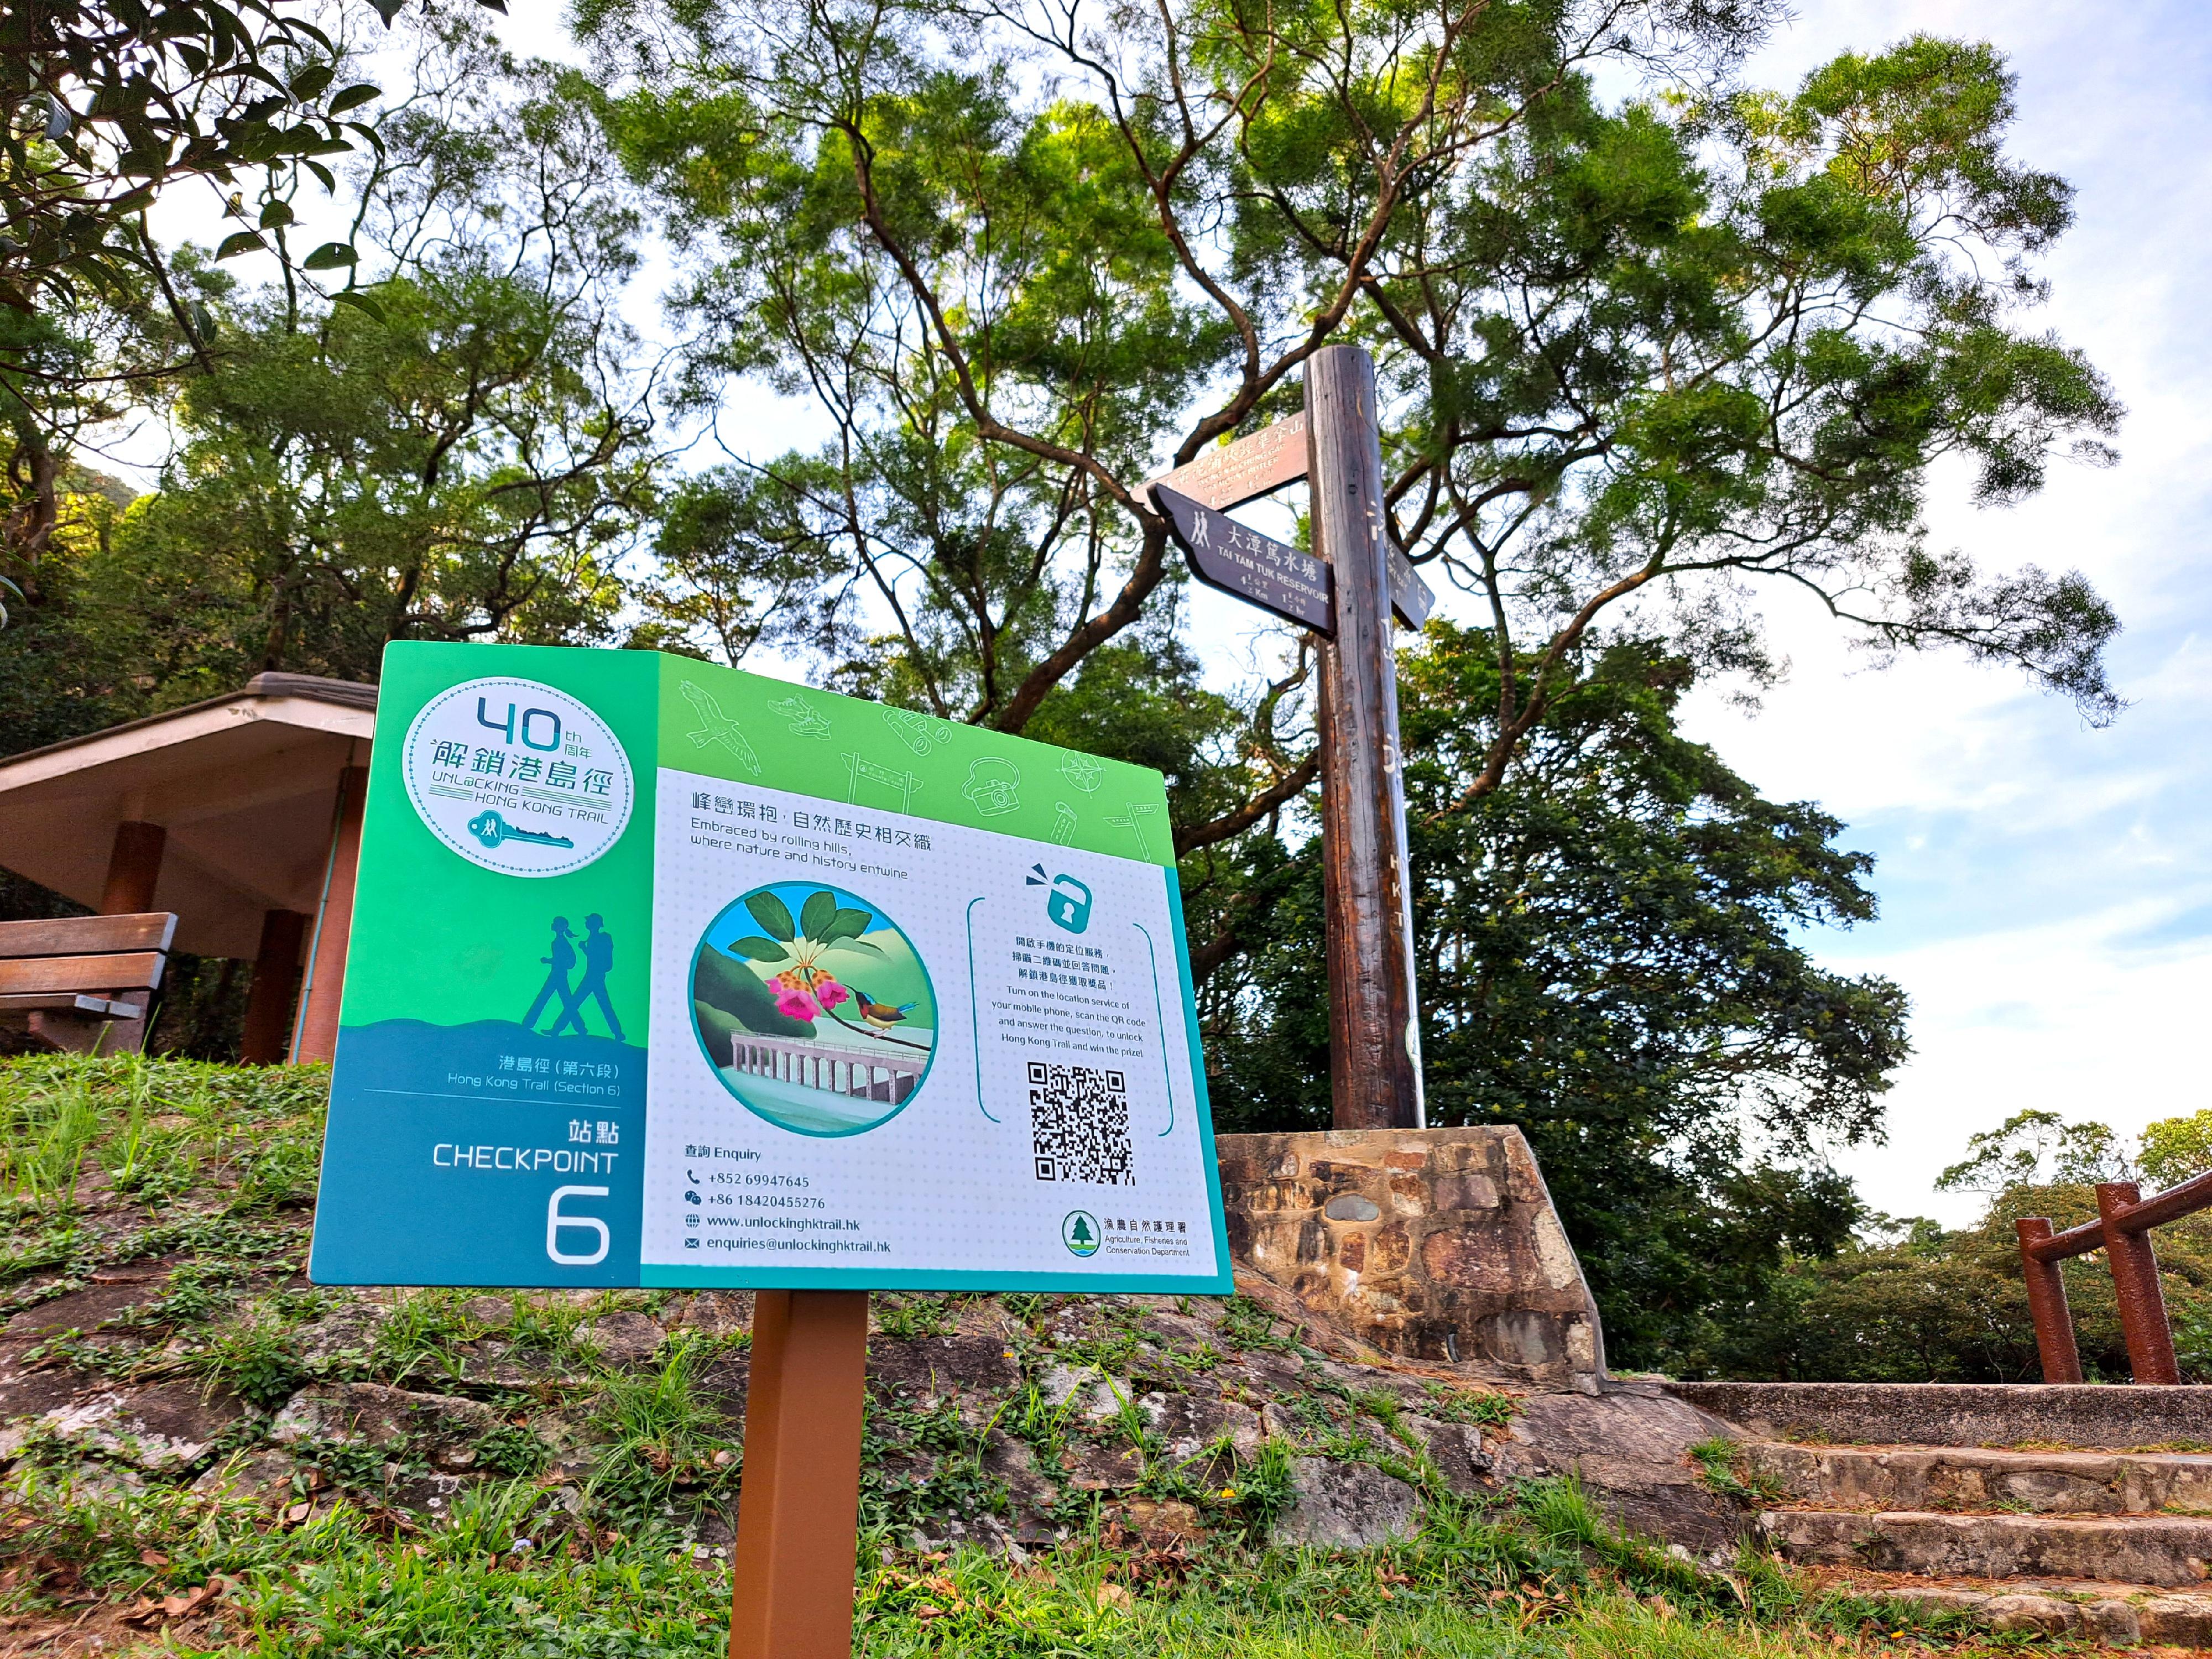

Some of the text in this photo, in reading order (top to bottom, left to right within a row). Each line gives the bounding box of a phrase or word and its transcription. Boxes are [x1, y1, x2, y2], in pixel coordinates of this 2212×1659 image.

[1247, 456, 1279, 475] BUTLER
[1228, 525, 1317, 581] 大潭篤水塘
[1217, 545, 1328, 604] TAI TAM TUK RESERVOIR
[477, 697, 561, 752] 40
[565, 744, 593, 759] 周年
[431, 739, 614, 796] 解鎖港島徑
[475, 792, 608, 824] HONG KONG TRAIL
[691, 817, 852, 856] Embraced by rolling hills,
[691, 834, 907, 880] where nature and history entwine
[1006, 985, 1026, 996] Turn
[1041, 990, 1055, 1000] the
[1056, 992, 1089, 1005] location
[1092, 998, 1119, 1009] service
[1121, 1001, 1130, 1010] of
[992, 1000, 1146, 1027] your mobile phone, scan the QR code
[998, 1018, 1143, 1042] and answer the question, to unlock
[1001, 1034, 1025, 1045] Hong
[1027, 1036, 1050, 1048] Kong
[1052, 1039, 1070, 1049] Trail
[1072, 1041, 1088, 1051] and
[1089, 1044, 1104, 1053] win
[1106, 1045, 1119, 1055] the
[448, 1073, 620, 1097] Hong Kong Trail (Section 6)
[568, 1119, 619, 1144] 站點
[434, 1144, 618, 1173] CHECKPOINT
[685, 1144, 761, 1163] 查詢 Enquiry
[708, 1173, 810, 1188] +852 69947645
[708, 1193, 825, 1209] +86 18420455276
[546, 1185, 610, 1265] 6
[707, 1216, 860, 1233] www.unlockinghktrail.hk
[1104, 1217, 1187, 1234] 漁農自然護理署
[707, 1237, 891, 1254] enquiries@unlockinghktrail.hk
[1106, 1246, 1190, 1257] Conservation Department
[1145, 1236, 1173, 1245] Fisheries
